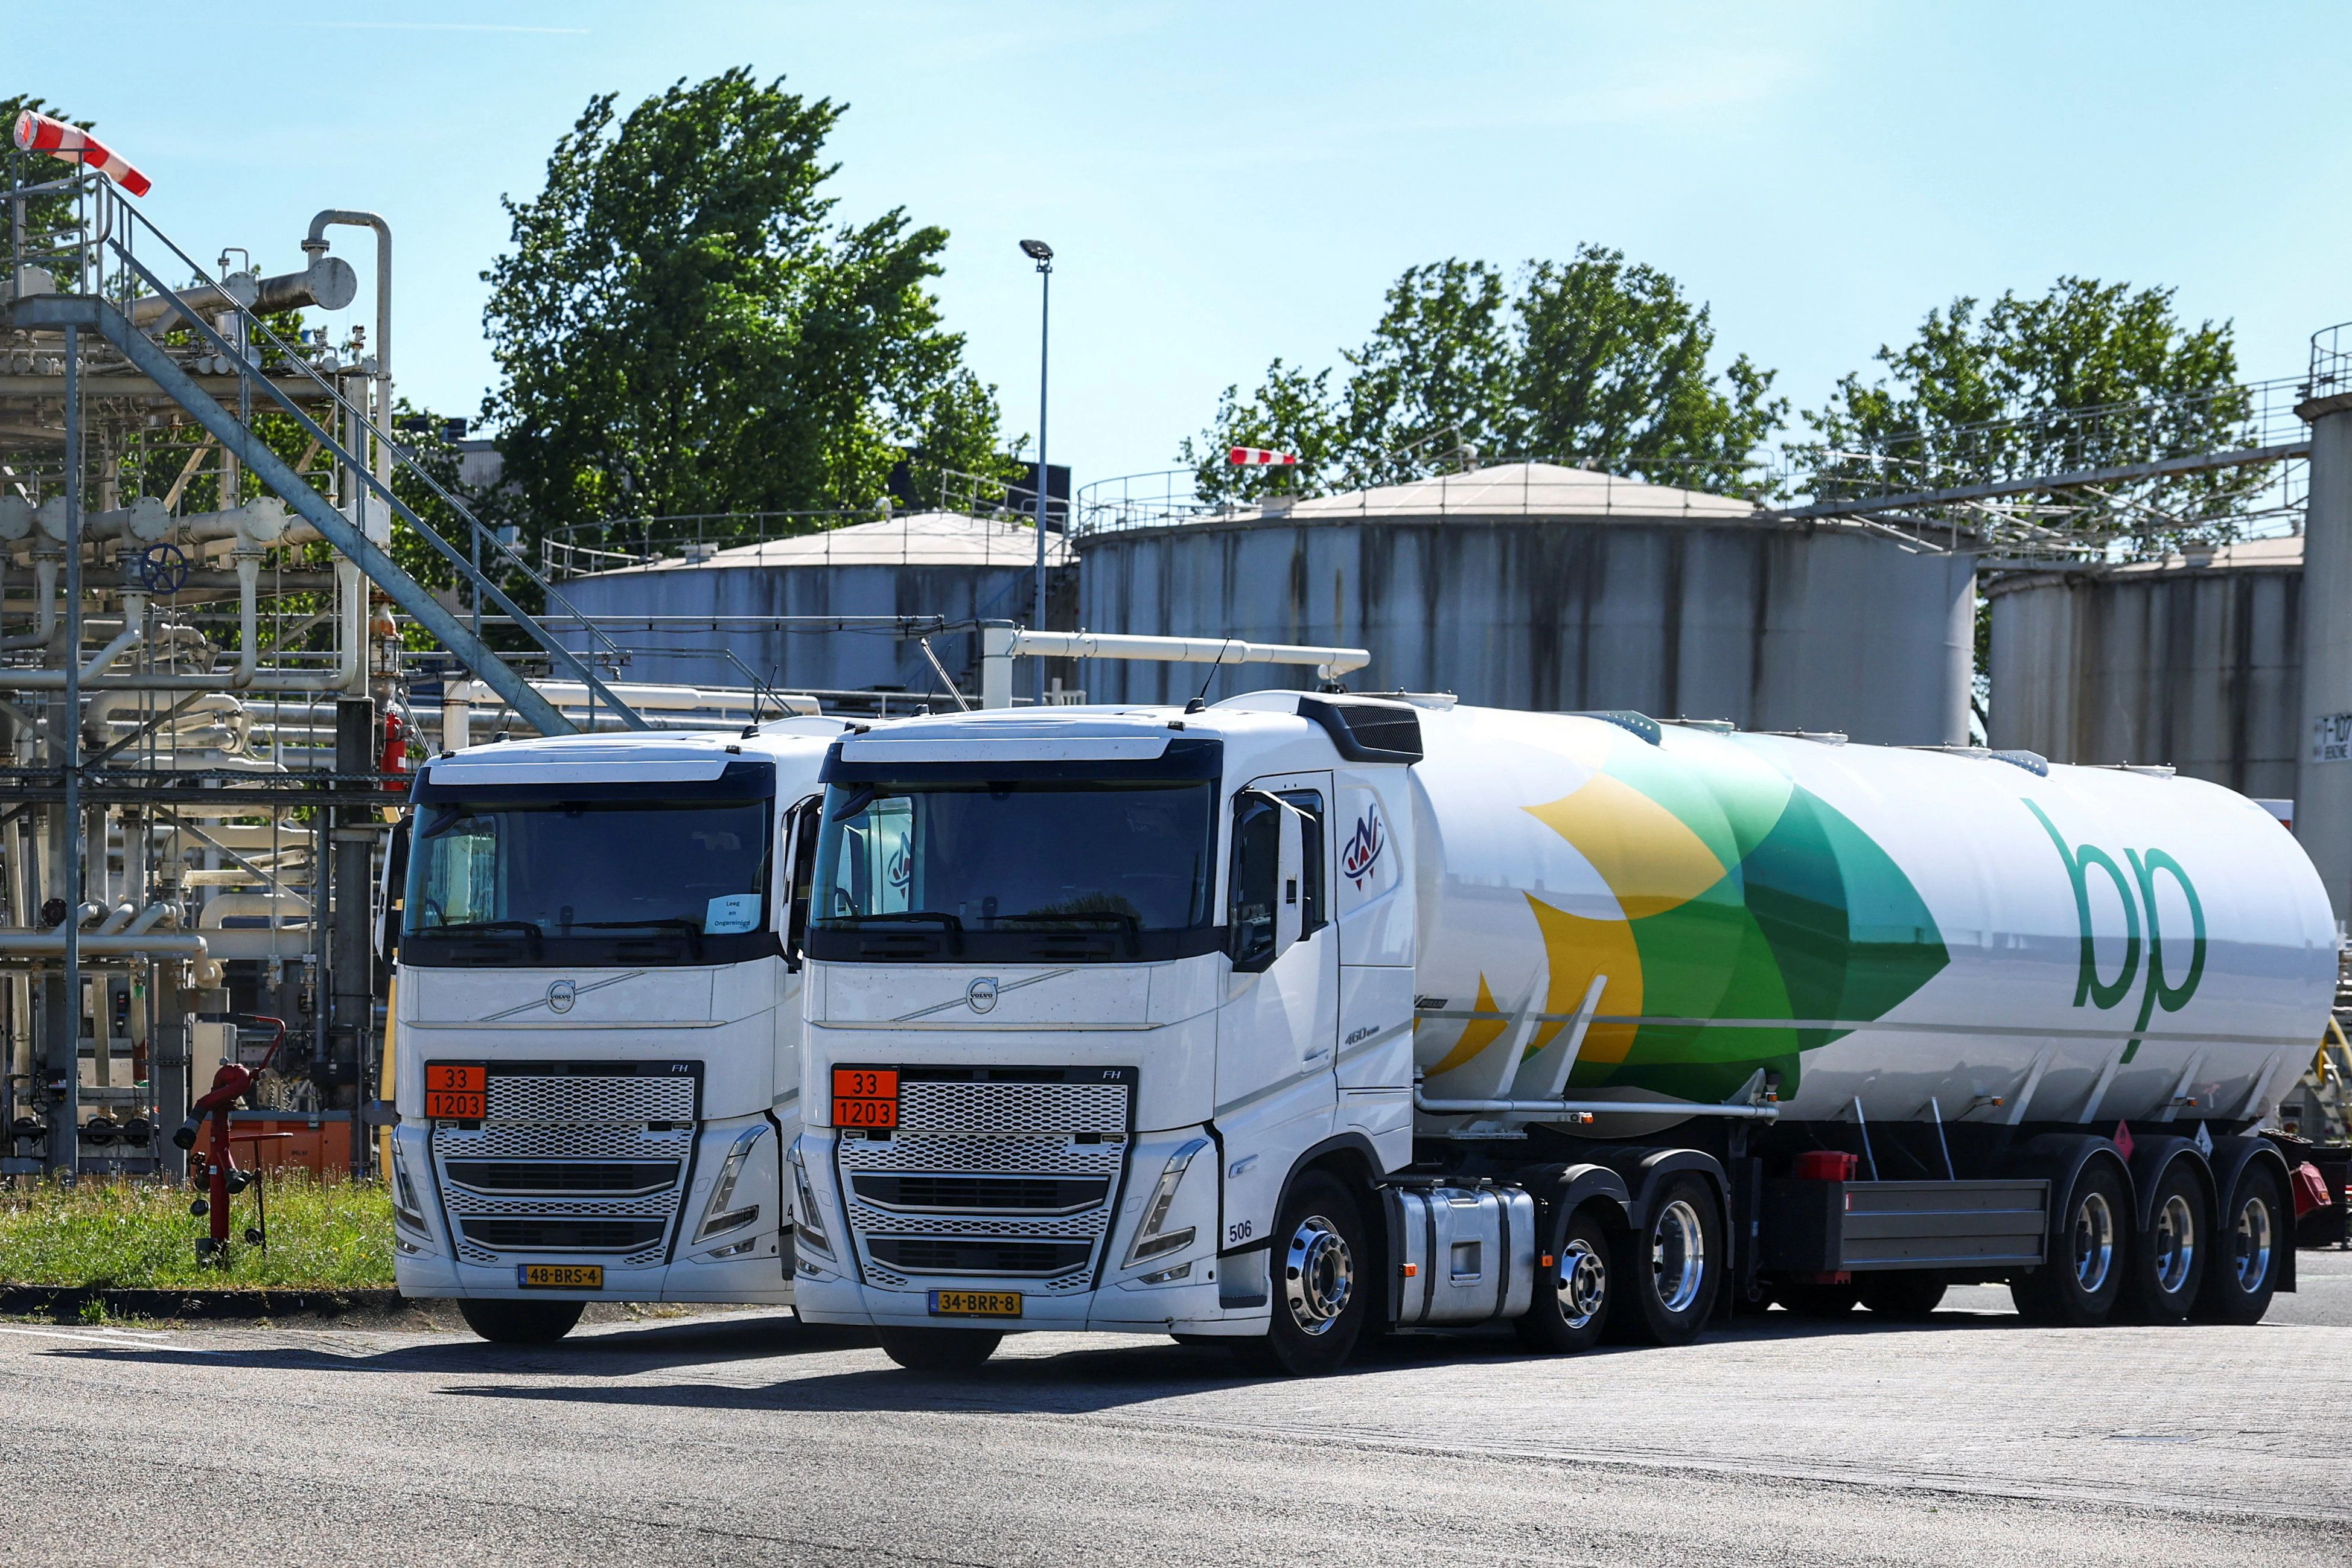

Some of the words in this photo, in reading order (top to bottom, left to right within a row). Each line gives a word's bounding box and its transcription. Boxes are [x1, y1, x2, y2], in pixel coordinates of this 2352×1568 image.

[2019, 798, 2207, 1064] bp
[1345, 1027, 1366, 1045] 460
[445, 1069, 467, 1088] 33
[853, 1073, 877, 1094] 33
[435, 1095, 479, 1115] 1203
[841, 1102, 890, 1124] 1203
[1229, 1220, 1252, 1242] 506
[531, 1269, 597, 1283] 48-BRS-4
[942, 1294, 1014, 1311] 34-BRR-8
